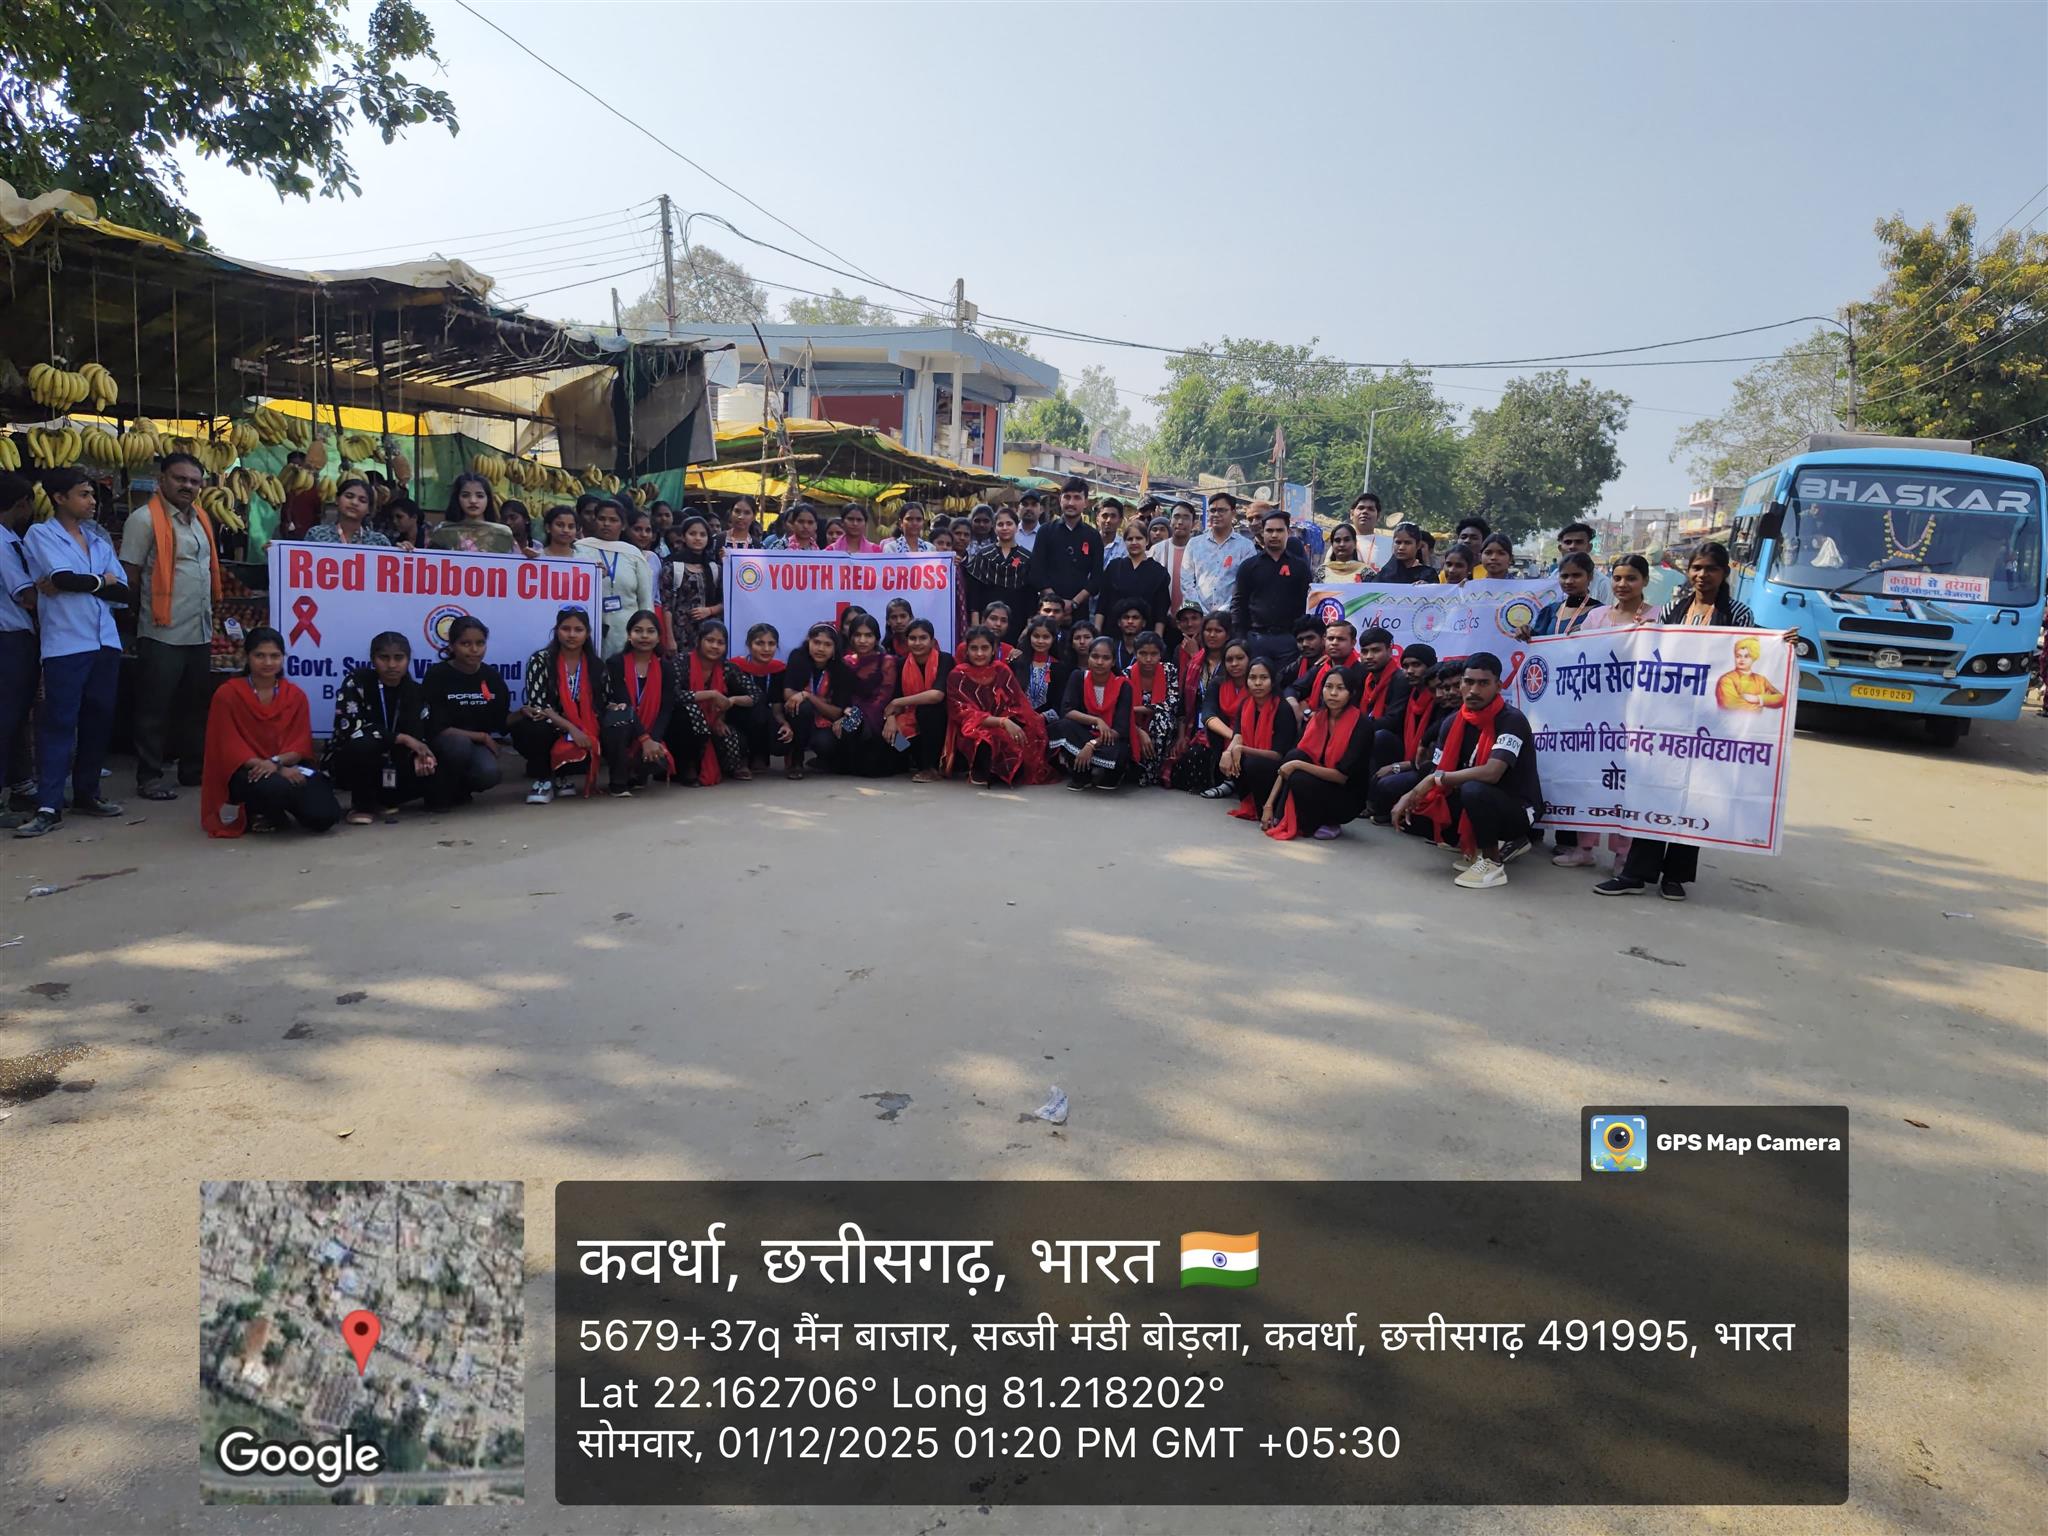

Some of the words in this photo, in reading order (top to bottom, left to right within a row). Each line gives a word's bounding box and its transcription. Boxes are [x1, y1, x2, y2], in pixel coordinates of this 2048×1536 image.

[1799, 477, 2031, 513] BHASKAR
[289, 549, 365, 591] Red
[377, 554, 507, 598] Ribbon
[517, 562, 590, 601] Club
[768, 563, 834, 591] YOUTH
[839, 564, 877, 591] RED
[882, 563, 948, 591] CROSS
[1362, 612, 1402, 629] NACO
[287, 655, 338, 677] Govt.
[1555, 651, 1602, 702] राष्ट्रीय
[1637, 647, 1711, 696] योजना
[1560, 721, 1597, 752] स्वामी
[1659, 726, 1774, 767] महाविद्यालय
